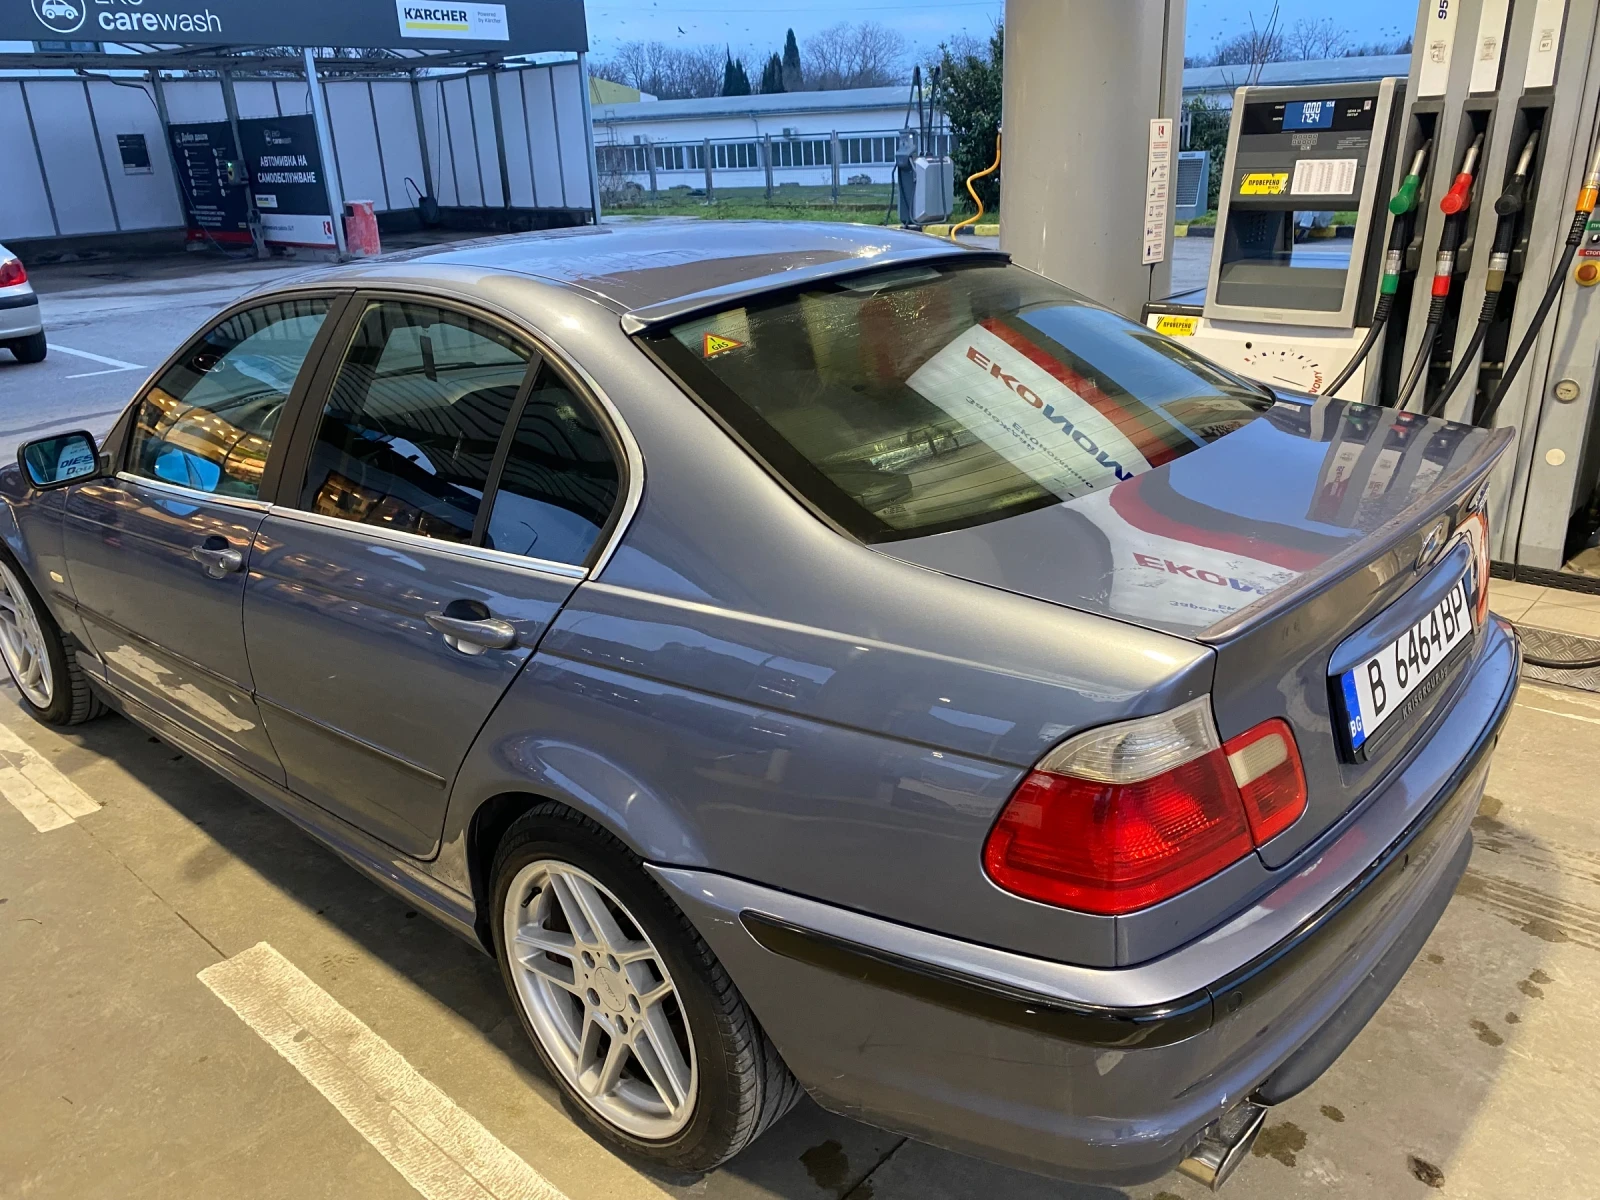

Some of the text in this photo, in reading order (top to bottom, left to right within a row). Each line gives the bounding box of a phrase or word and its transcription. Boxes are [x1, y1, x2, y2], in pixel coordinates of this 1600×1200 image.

[404, 7, 468, 22] KÄRCHER
[1438, 0, 1448, 20] 95
[98, 9, 222, 33] carewash
[260, 154, 308, 167] АВТОМИВКА НА
[257, 171, 316, 183] САМООБСЛУЖВАНЕ
[1163, 321, 1192, 329] ПРОВЕРЕНО
[711, 341, 729, 351] GAS
[1367, 583, 1463, 718] B 6464 BP
[1402, 665, 1448, 720] KRISGROUP.bg
[1350, 714, 1363, 738] BG
